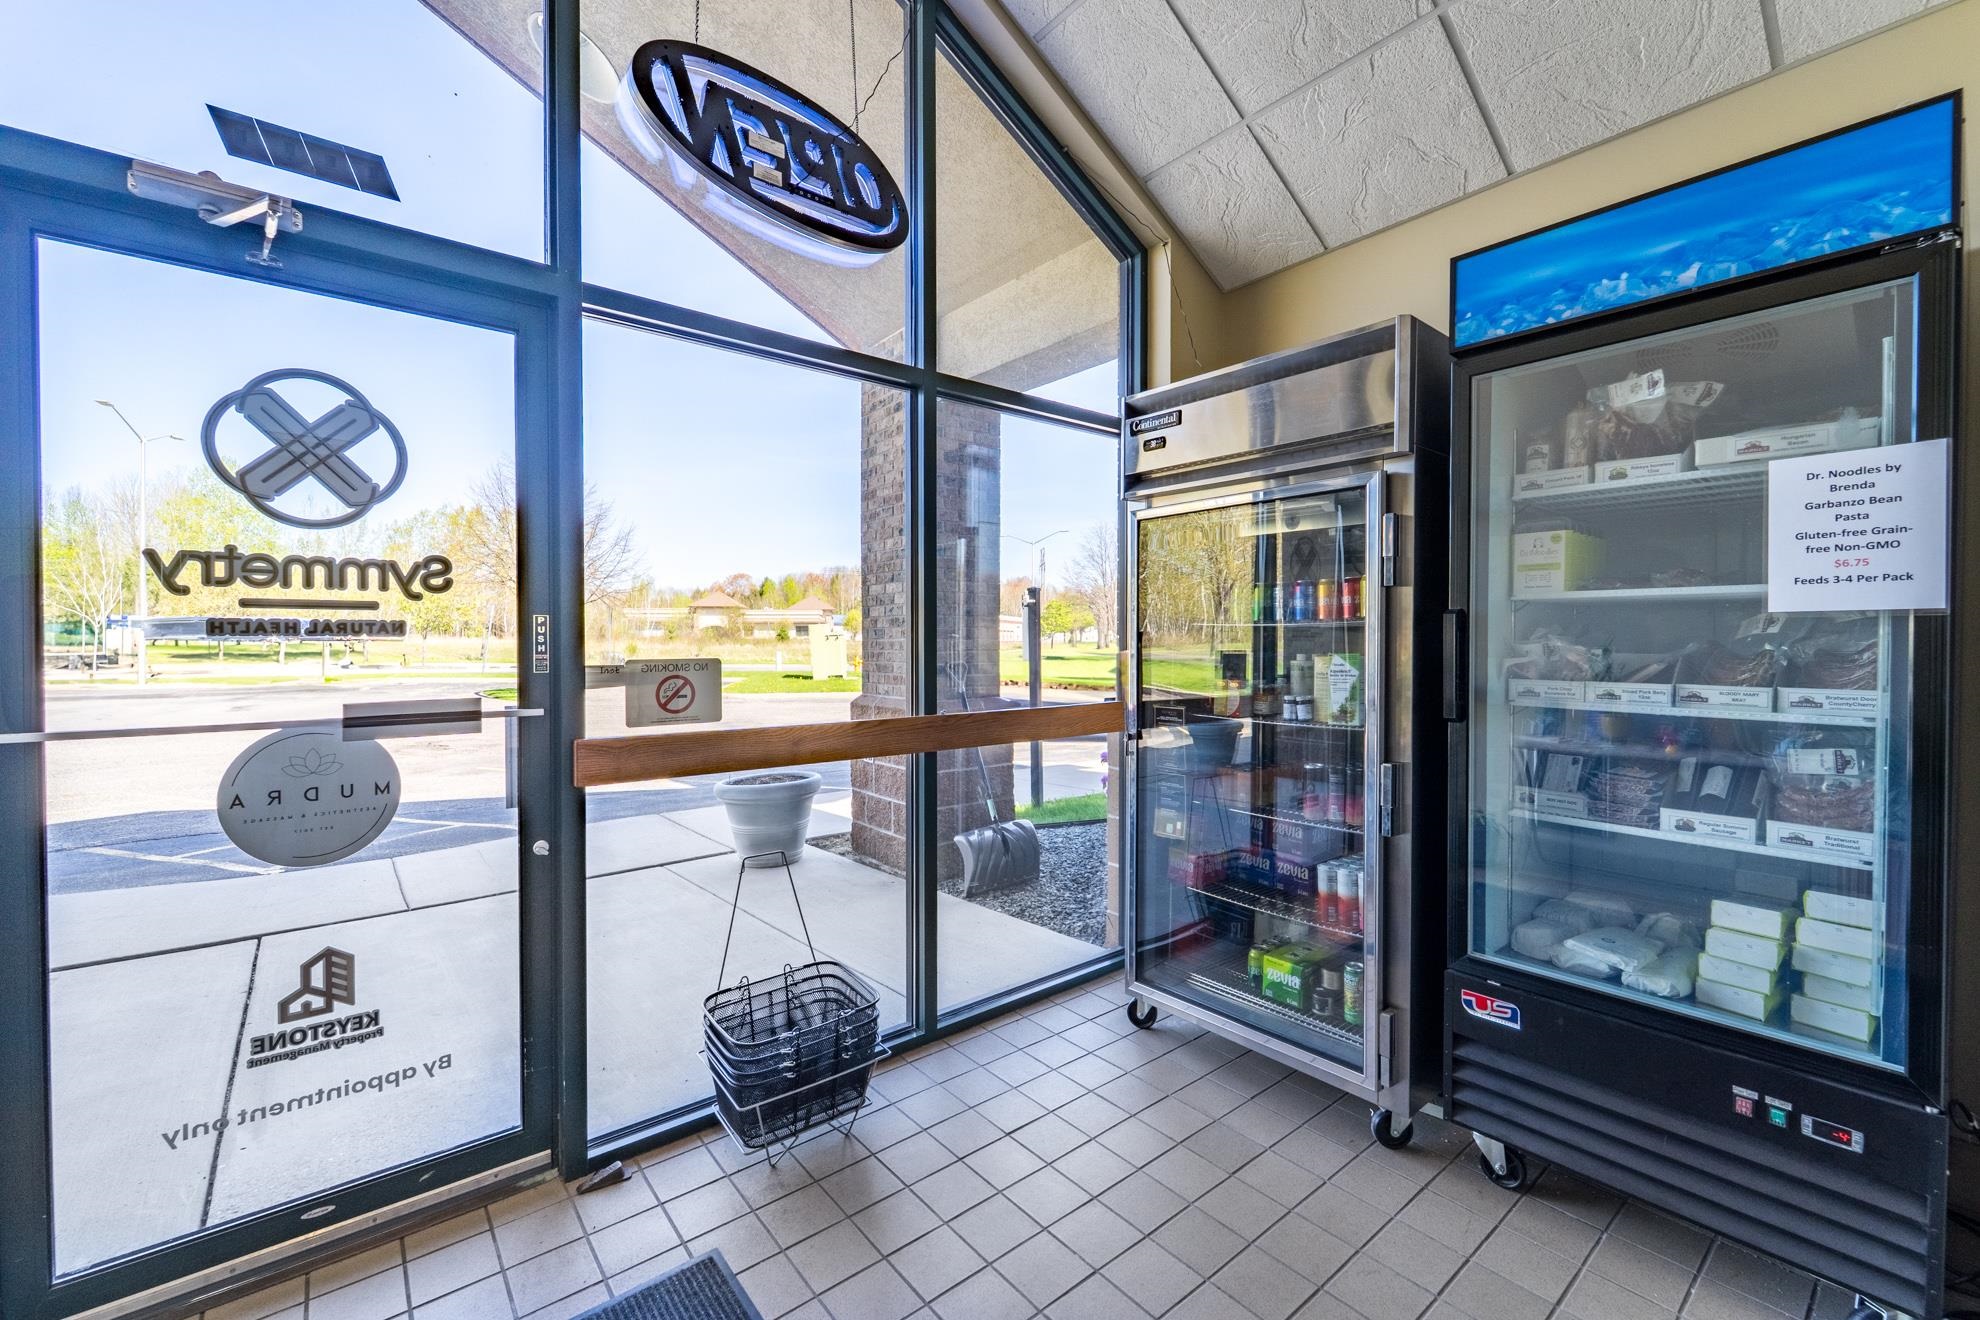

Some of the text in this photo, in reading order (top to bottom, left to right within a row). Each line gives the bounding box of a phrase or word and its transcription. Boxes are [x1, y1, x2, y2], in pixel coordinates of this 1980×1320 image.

[1132, 411, 1178, 431] Continental
[1806, 463, 1902, 481] Dr. Noodles by
[1829, 480, 1876, 492] Brenda
[1804, 494, 1903, 511] Garbanzo Bean
[1835, 512, 1870, 522] Pasta
[1795, 524, 1913, 541] Gluten-free Grain-
[1805, 539, 1901, 554] free Non-GMO
[1834, 558, 1870, 569] $6.75
[1794, 571, 1915, 585] Feeds 3-4 Per Pack
[537, 616, 546, 652] PUSH
[1711, 827, 1737, 836] Sausage
[1823, 840, 1861, 851] Traditional
[1824, 835, 1860, 845] Bratwurst
[1239, 852, 1270, 870] zevia
[1277, 861, 1309, 880] zevia
[1266, 967, 1300, 989] zevia
